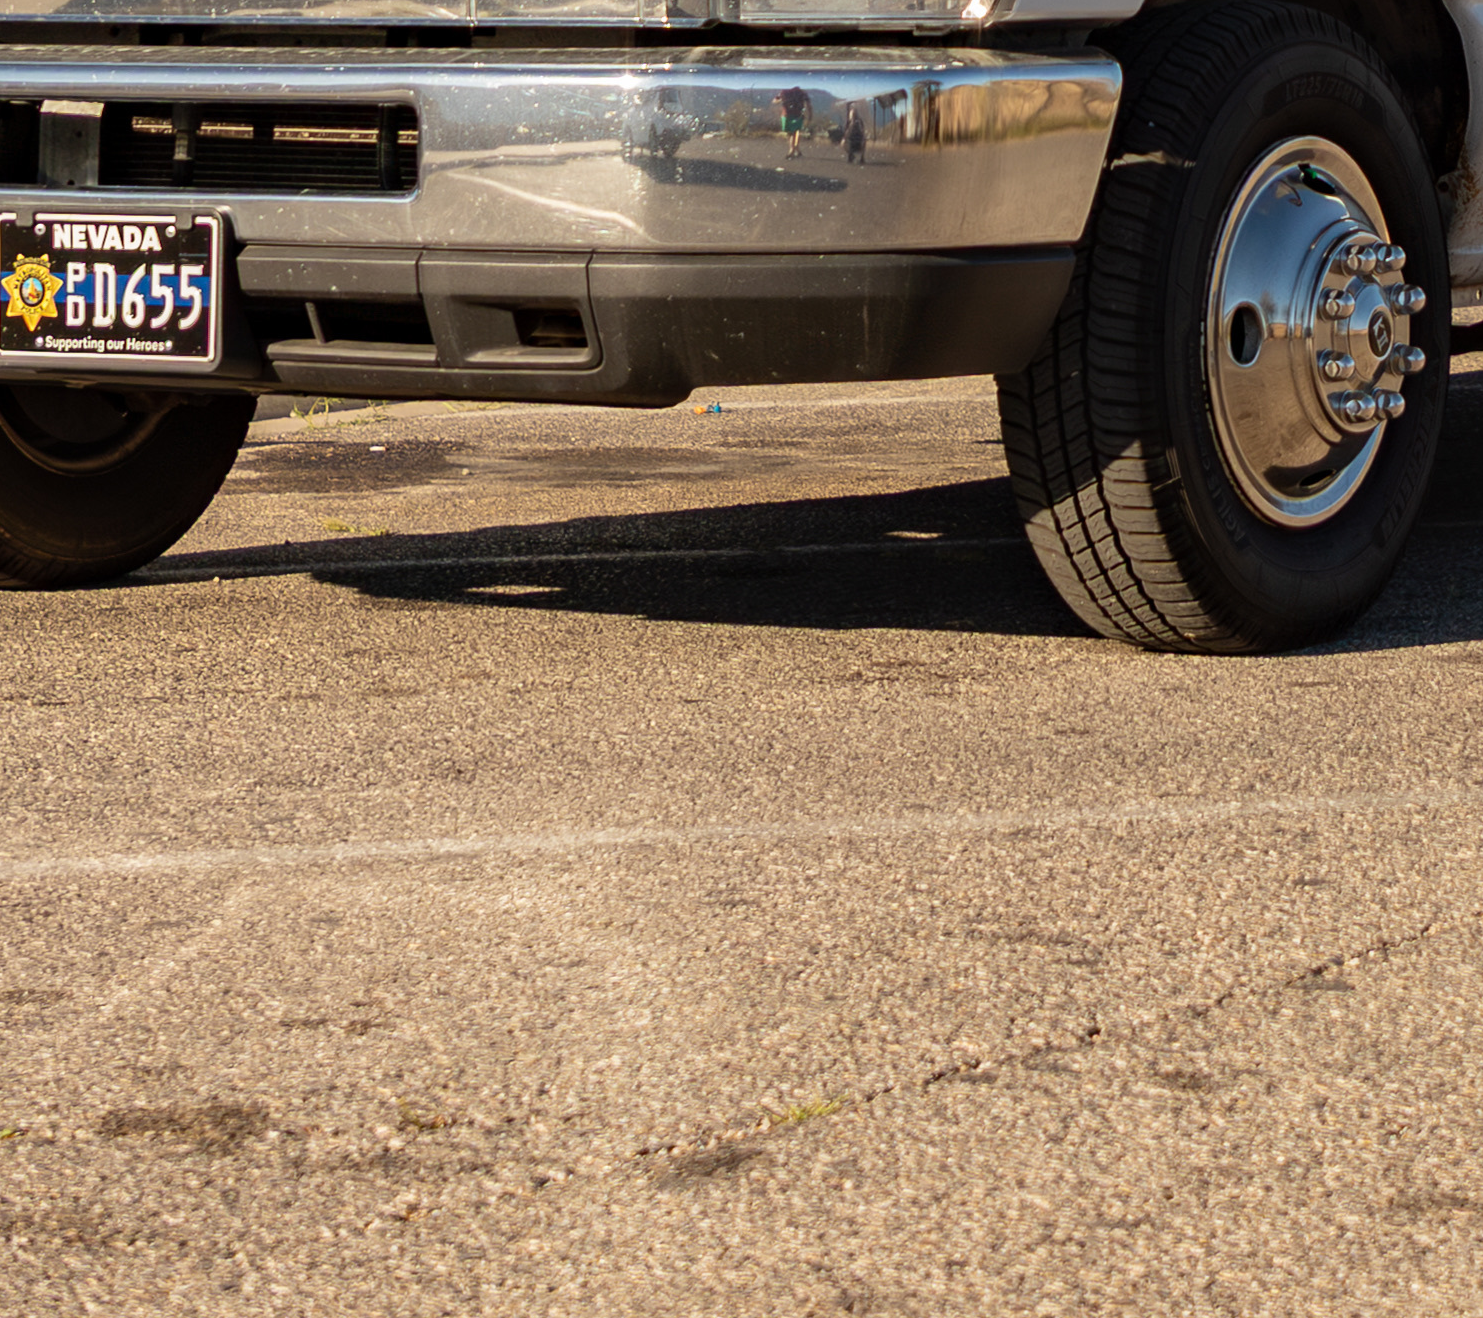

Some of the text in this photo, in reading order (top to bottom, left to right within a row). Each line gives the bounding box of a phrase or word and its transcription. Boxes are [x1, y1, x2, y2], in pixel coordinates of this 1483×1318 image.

[51, 224, 163, 252] NEVADA
[44, 335, 165, 352] Supporting our Heroes
